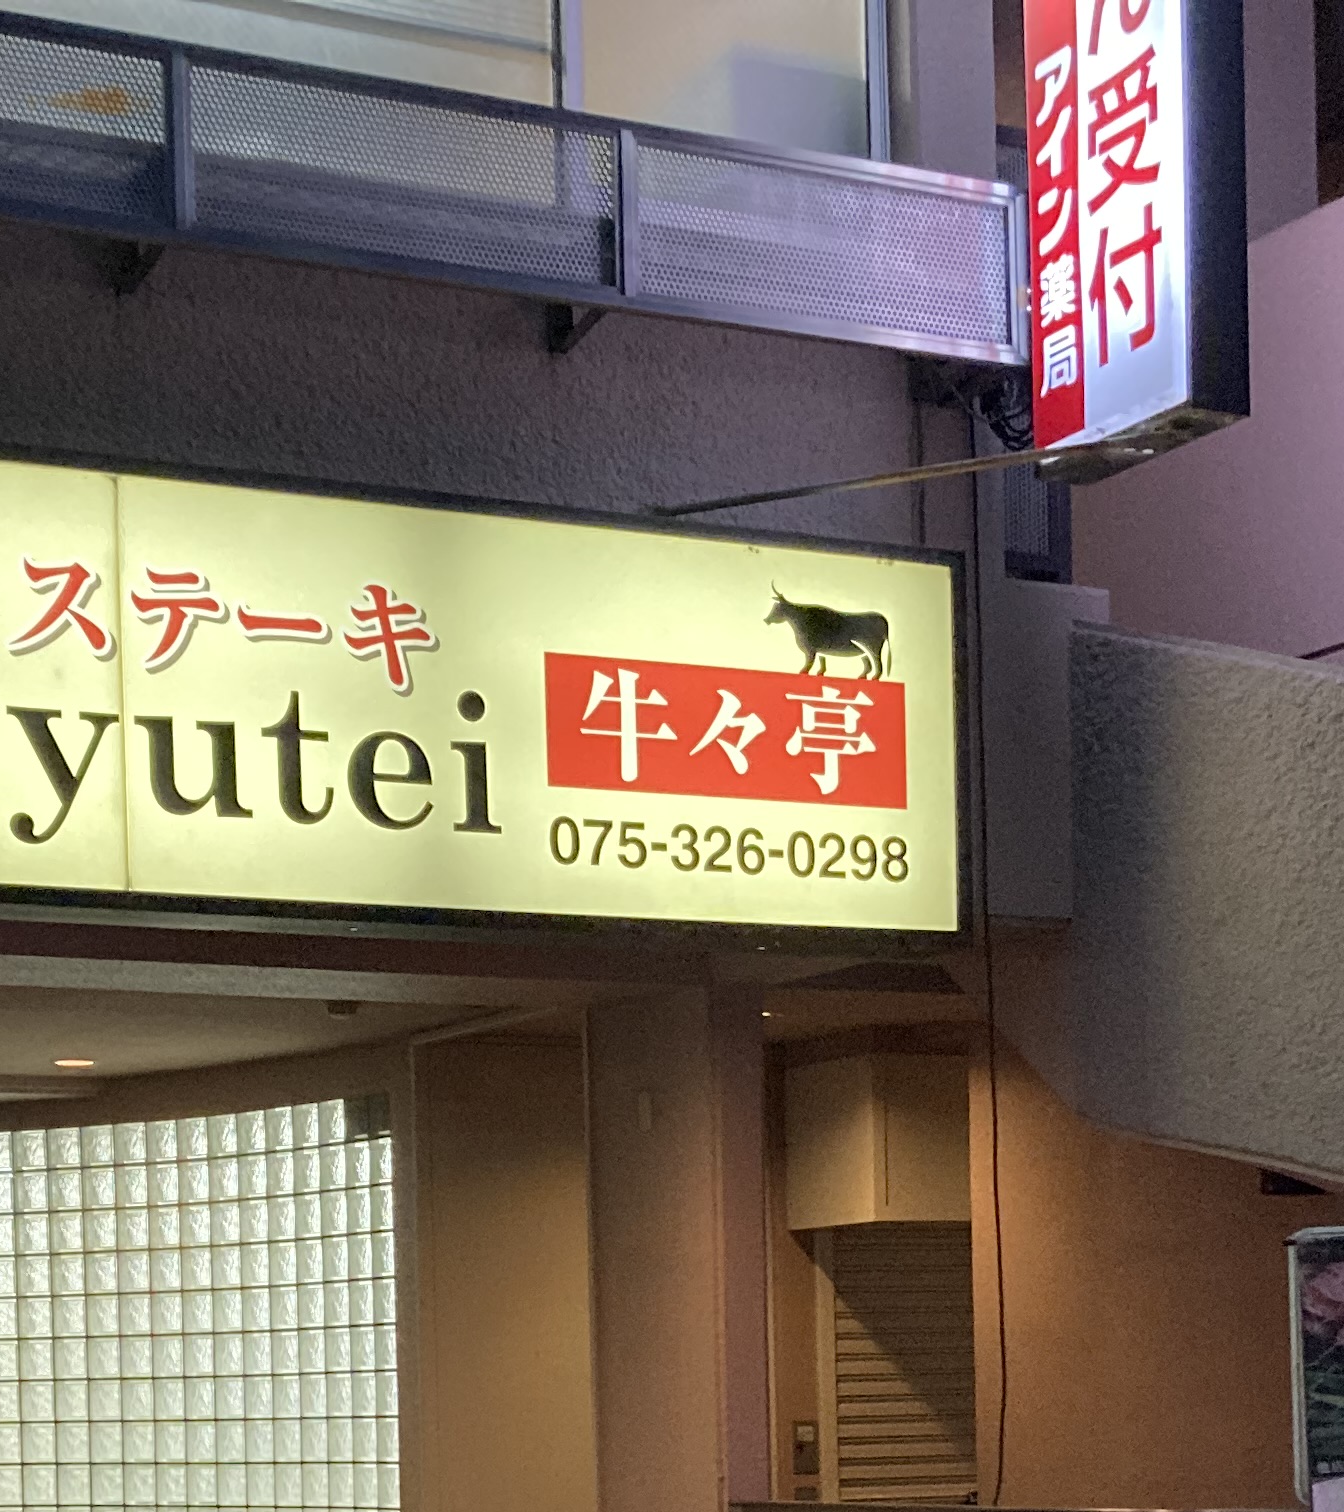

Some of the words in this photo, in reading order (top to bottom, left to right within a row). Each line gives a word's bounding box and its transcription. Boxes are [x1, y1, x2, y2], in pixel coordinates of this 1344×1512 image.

[1035, 45, 1076, 398] アイン薬局
[580, 668, 876, 796] 牛々亭
[549, 816, 909, 883] 075-326-0298
